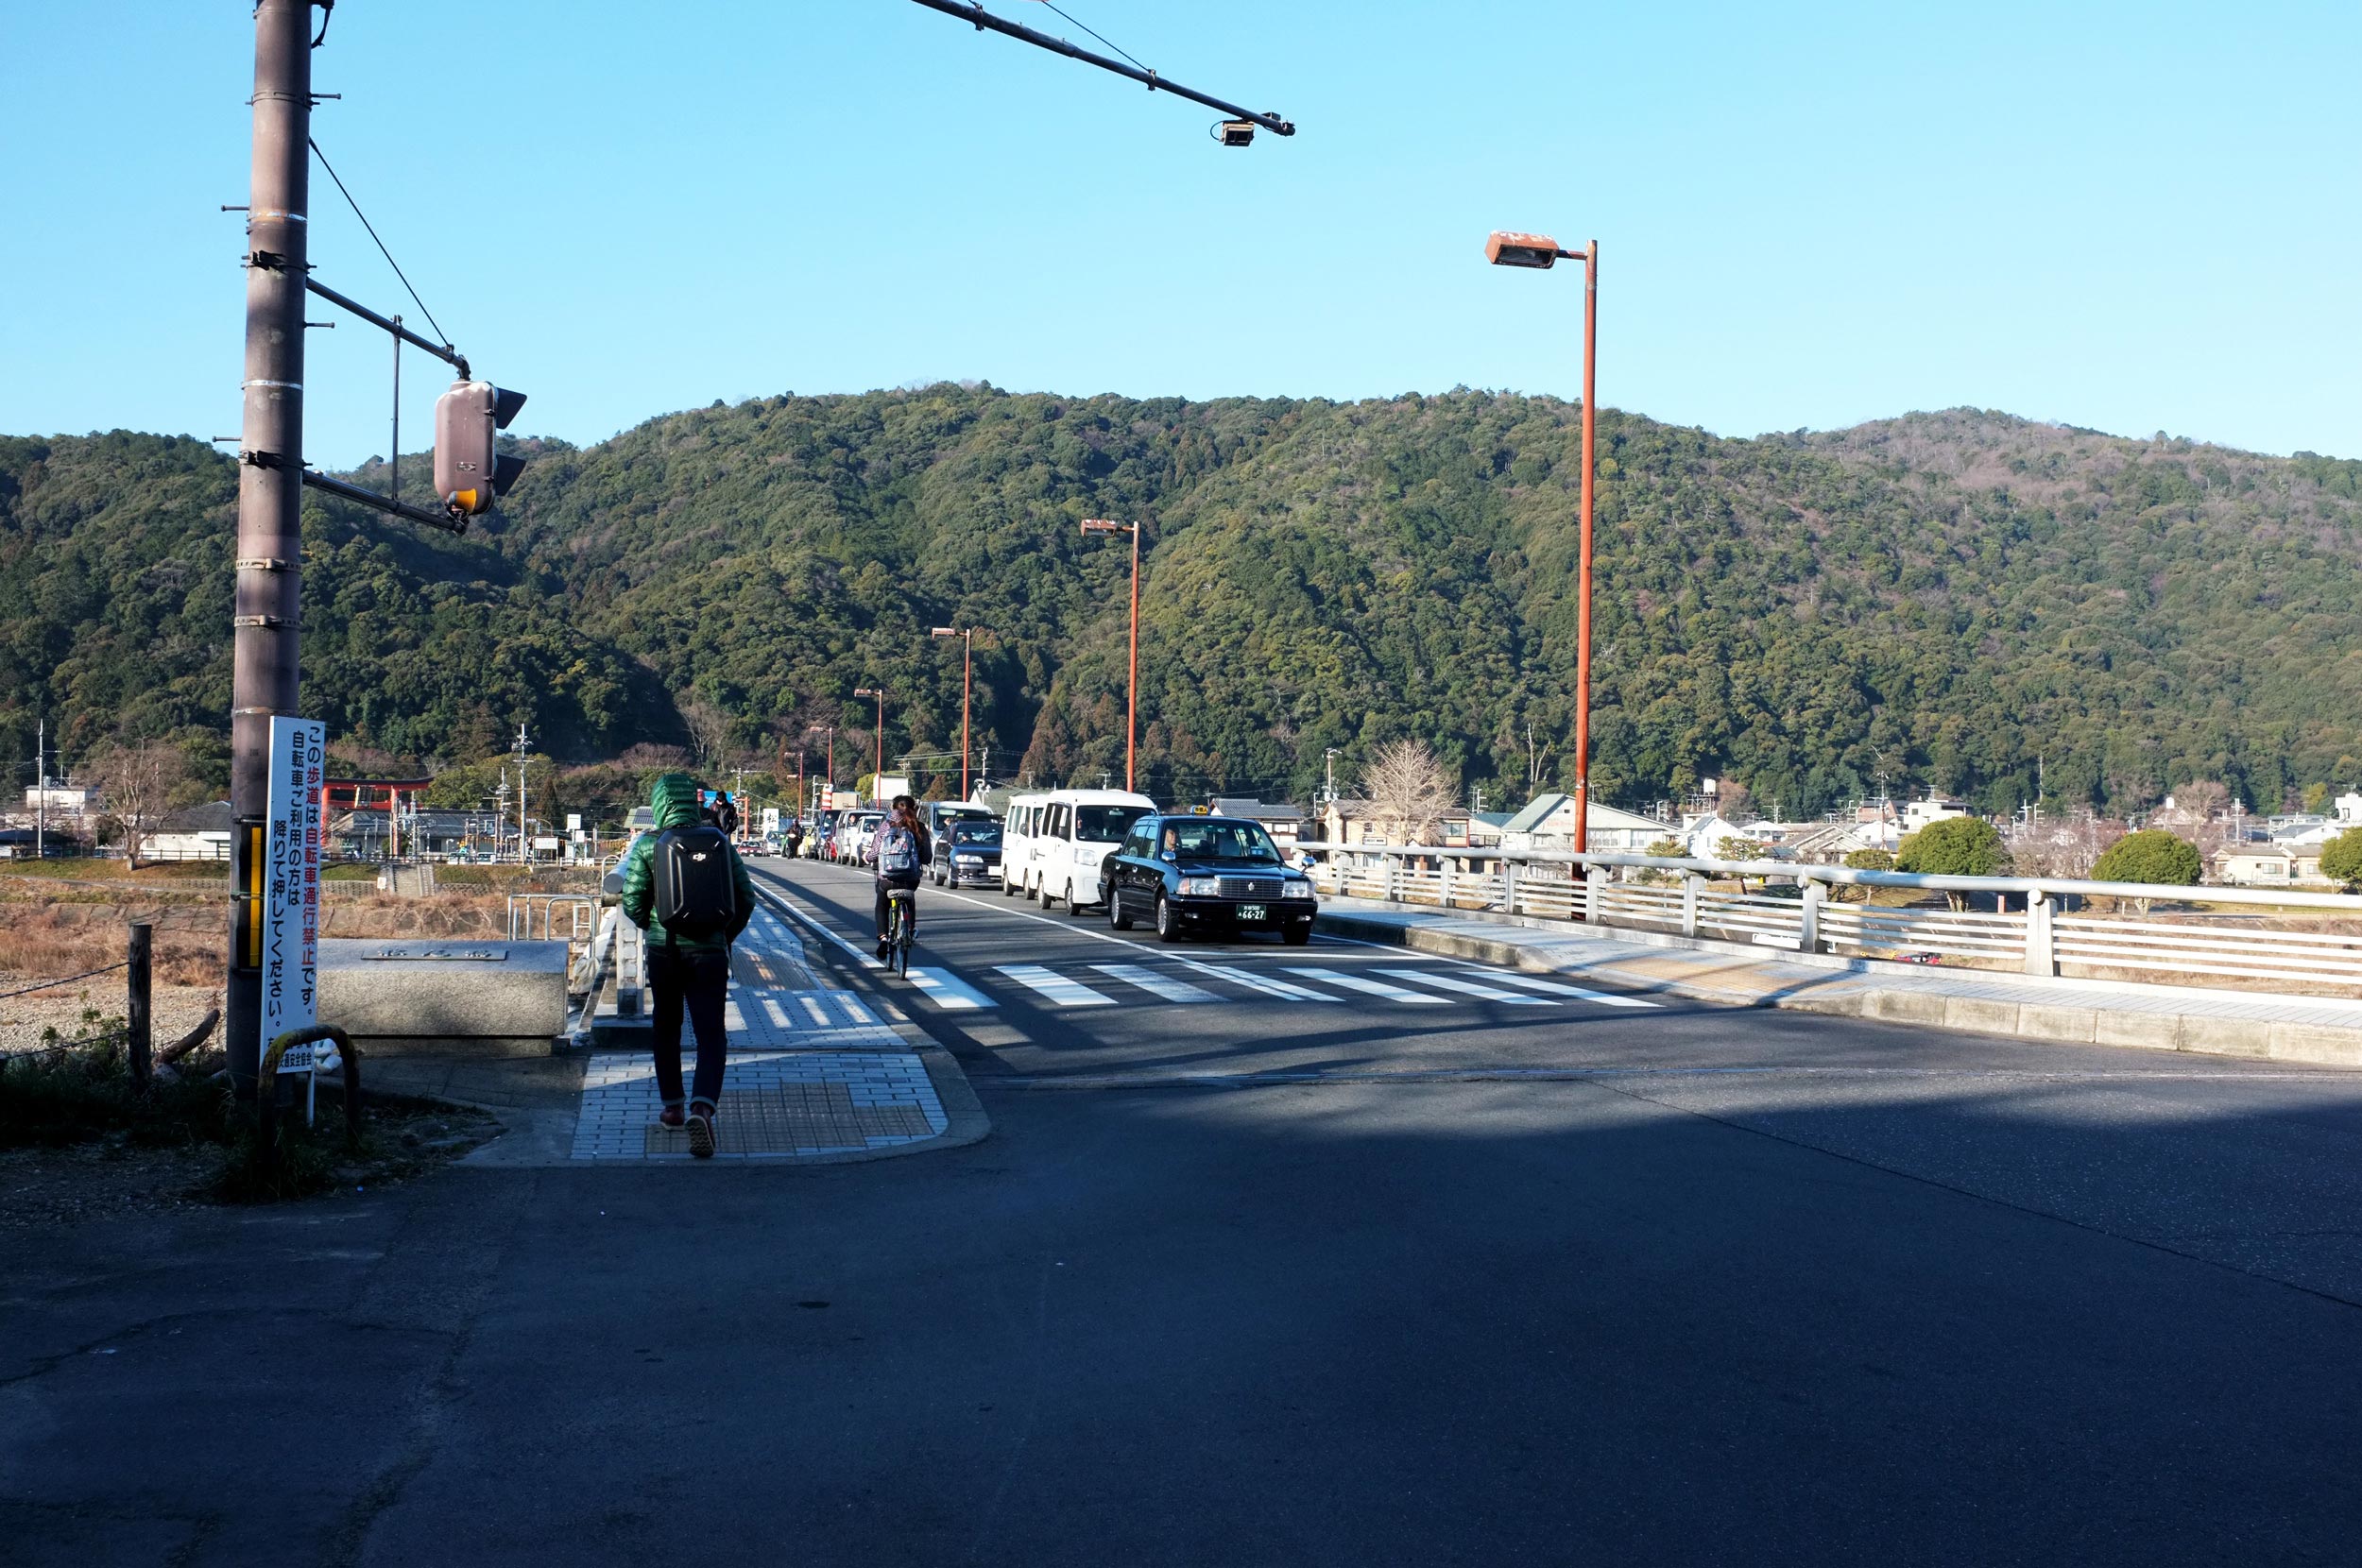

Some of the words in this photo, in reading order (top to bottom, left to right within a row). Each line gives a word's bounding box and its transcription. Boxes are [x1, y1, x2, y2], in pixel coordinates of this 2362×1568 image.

[287, 730, 304, 906] 自転車ご利用の方は
[300, 726, 321, 1014] この歩道は自転車通行禁止です。
[268, 820, 287, 1027] 降りて押してください。
[1242, 910, 1265, 919] 66-27
